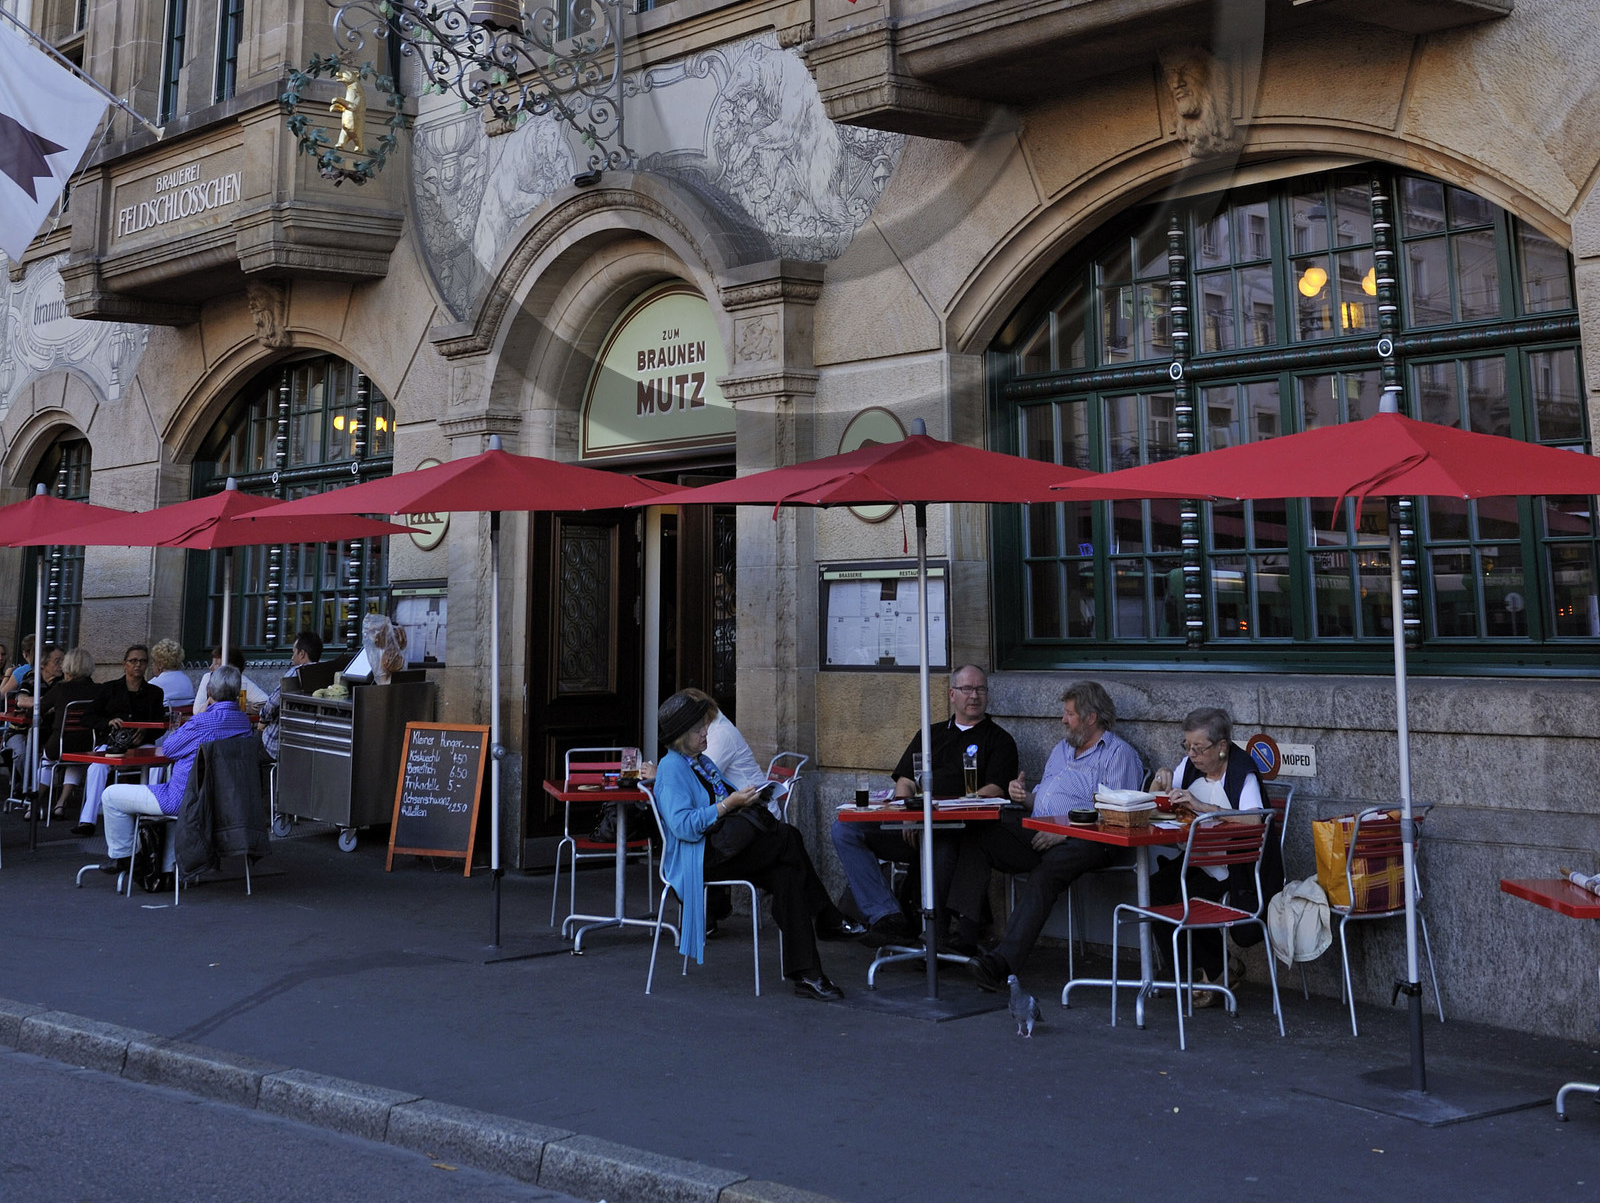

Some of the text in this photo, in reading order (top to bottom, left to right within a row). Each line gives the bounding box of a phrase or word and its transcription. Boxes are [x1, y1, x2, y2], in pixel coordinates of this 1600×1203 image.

[156, 164, 200, 193] BRAUEREI
[662, 328, 680, 341] ZUM
[637, 341, 706, 373] BRAUNEN
[636, 371, 706, 417] MUTZ
[412, 731, 435, 746] Kleiner
[1281, 754, 1311, 766] MOPED
[450, 765, 468, 779] 6.50
[405, 775, 440, 791] Frikadelle
